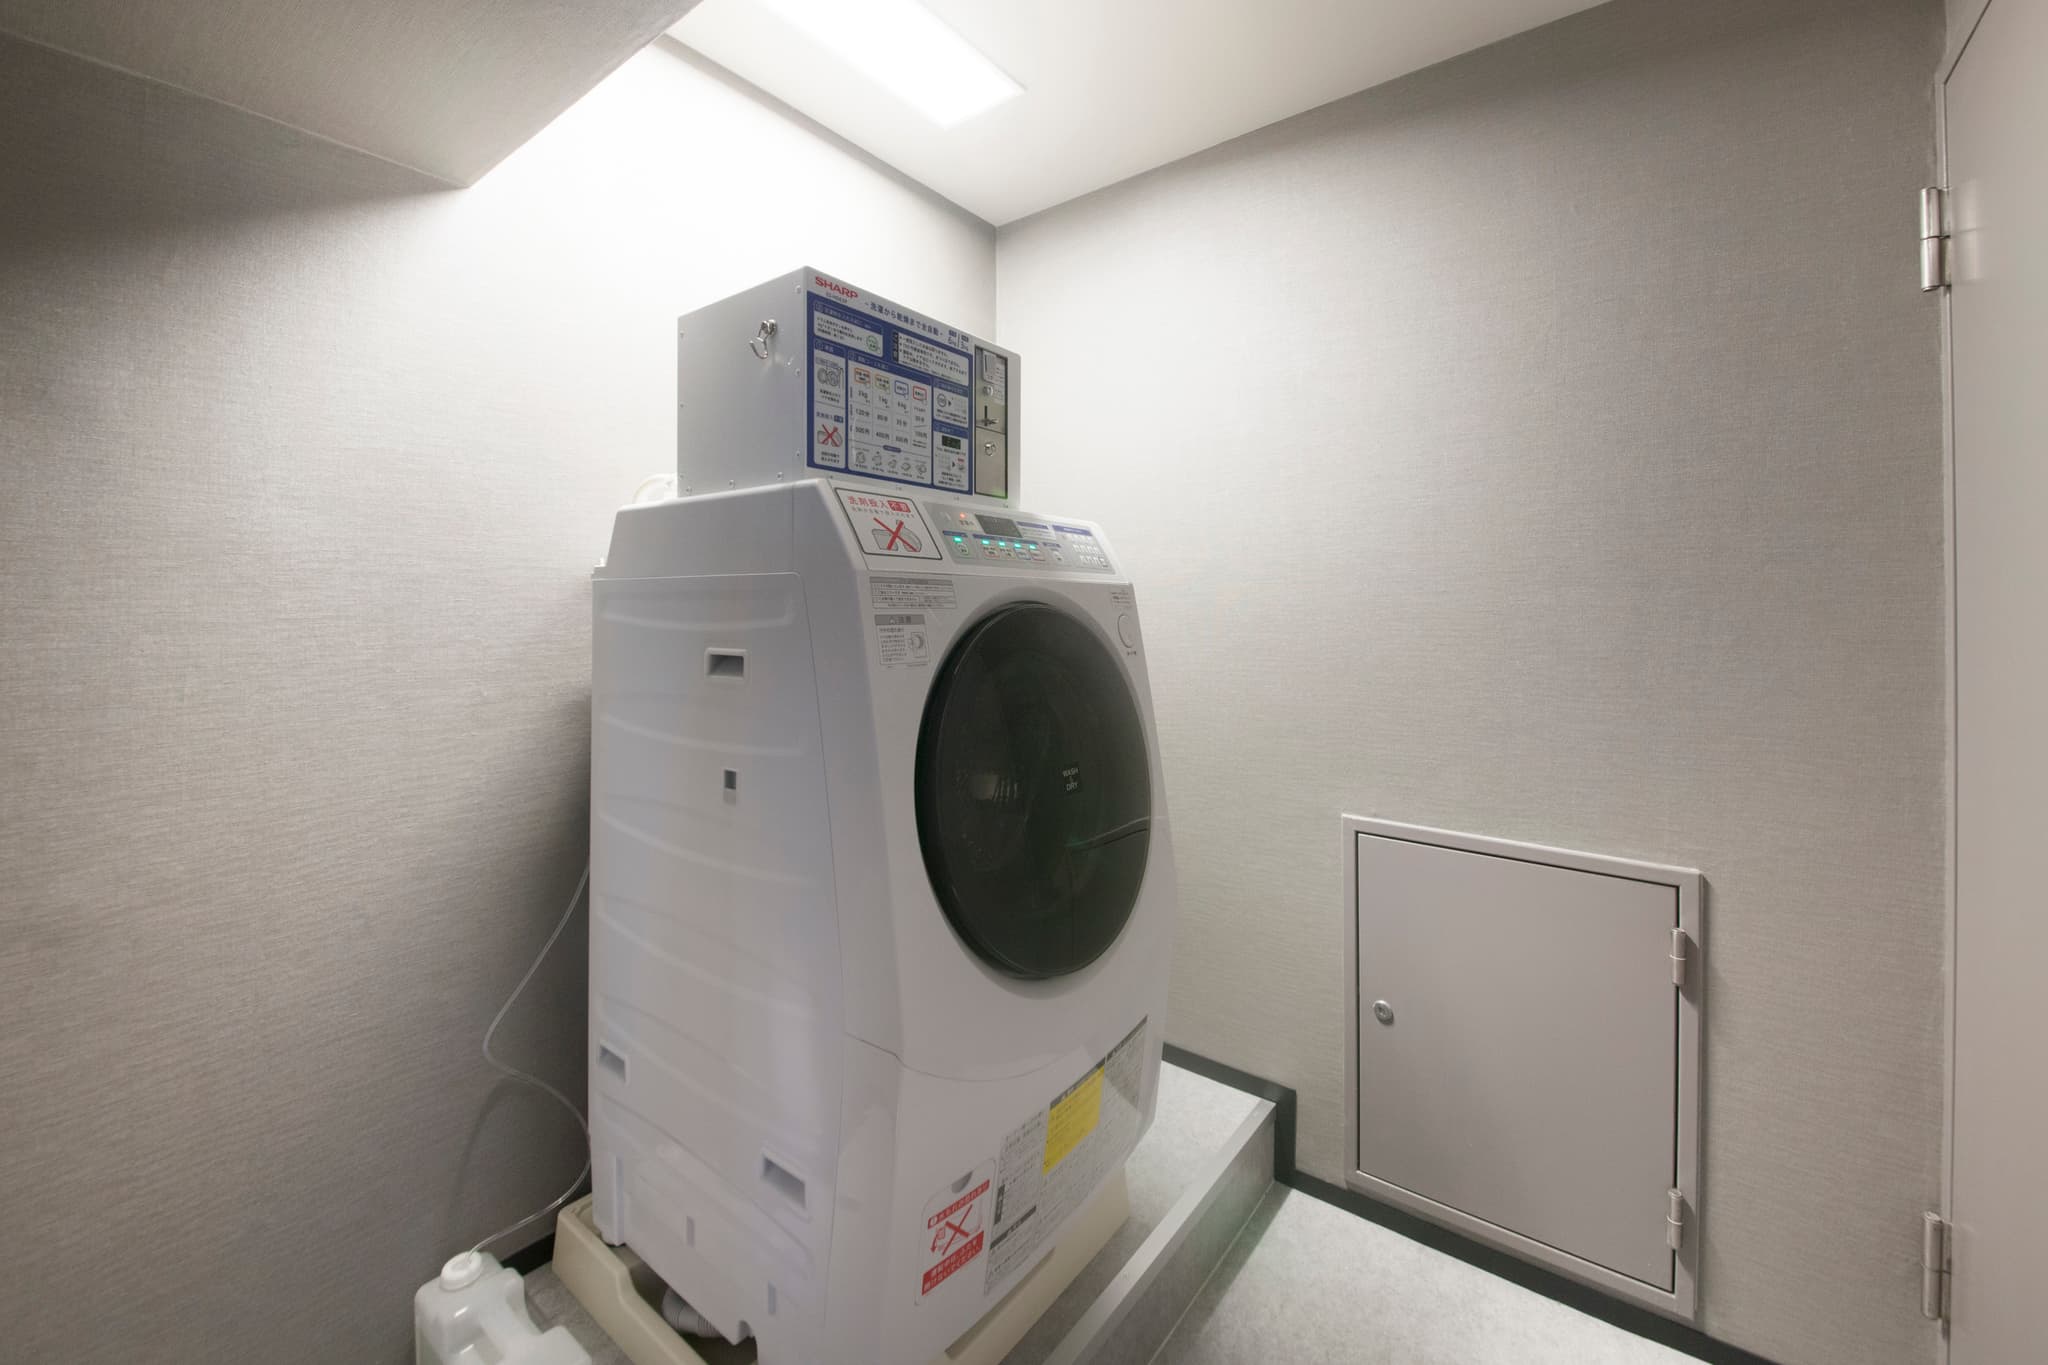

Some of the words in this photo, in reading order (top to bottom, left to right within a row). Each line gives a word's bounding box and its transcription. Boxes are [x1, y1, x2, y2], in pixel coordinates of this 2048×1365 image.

[815, 276, 858, 300] SHARP
[1063, 768, 1078, 777] WASH
[1066, 783, 1078, 791] DRY
